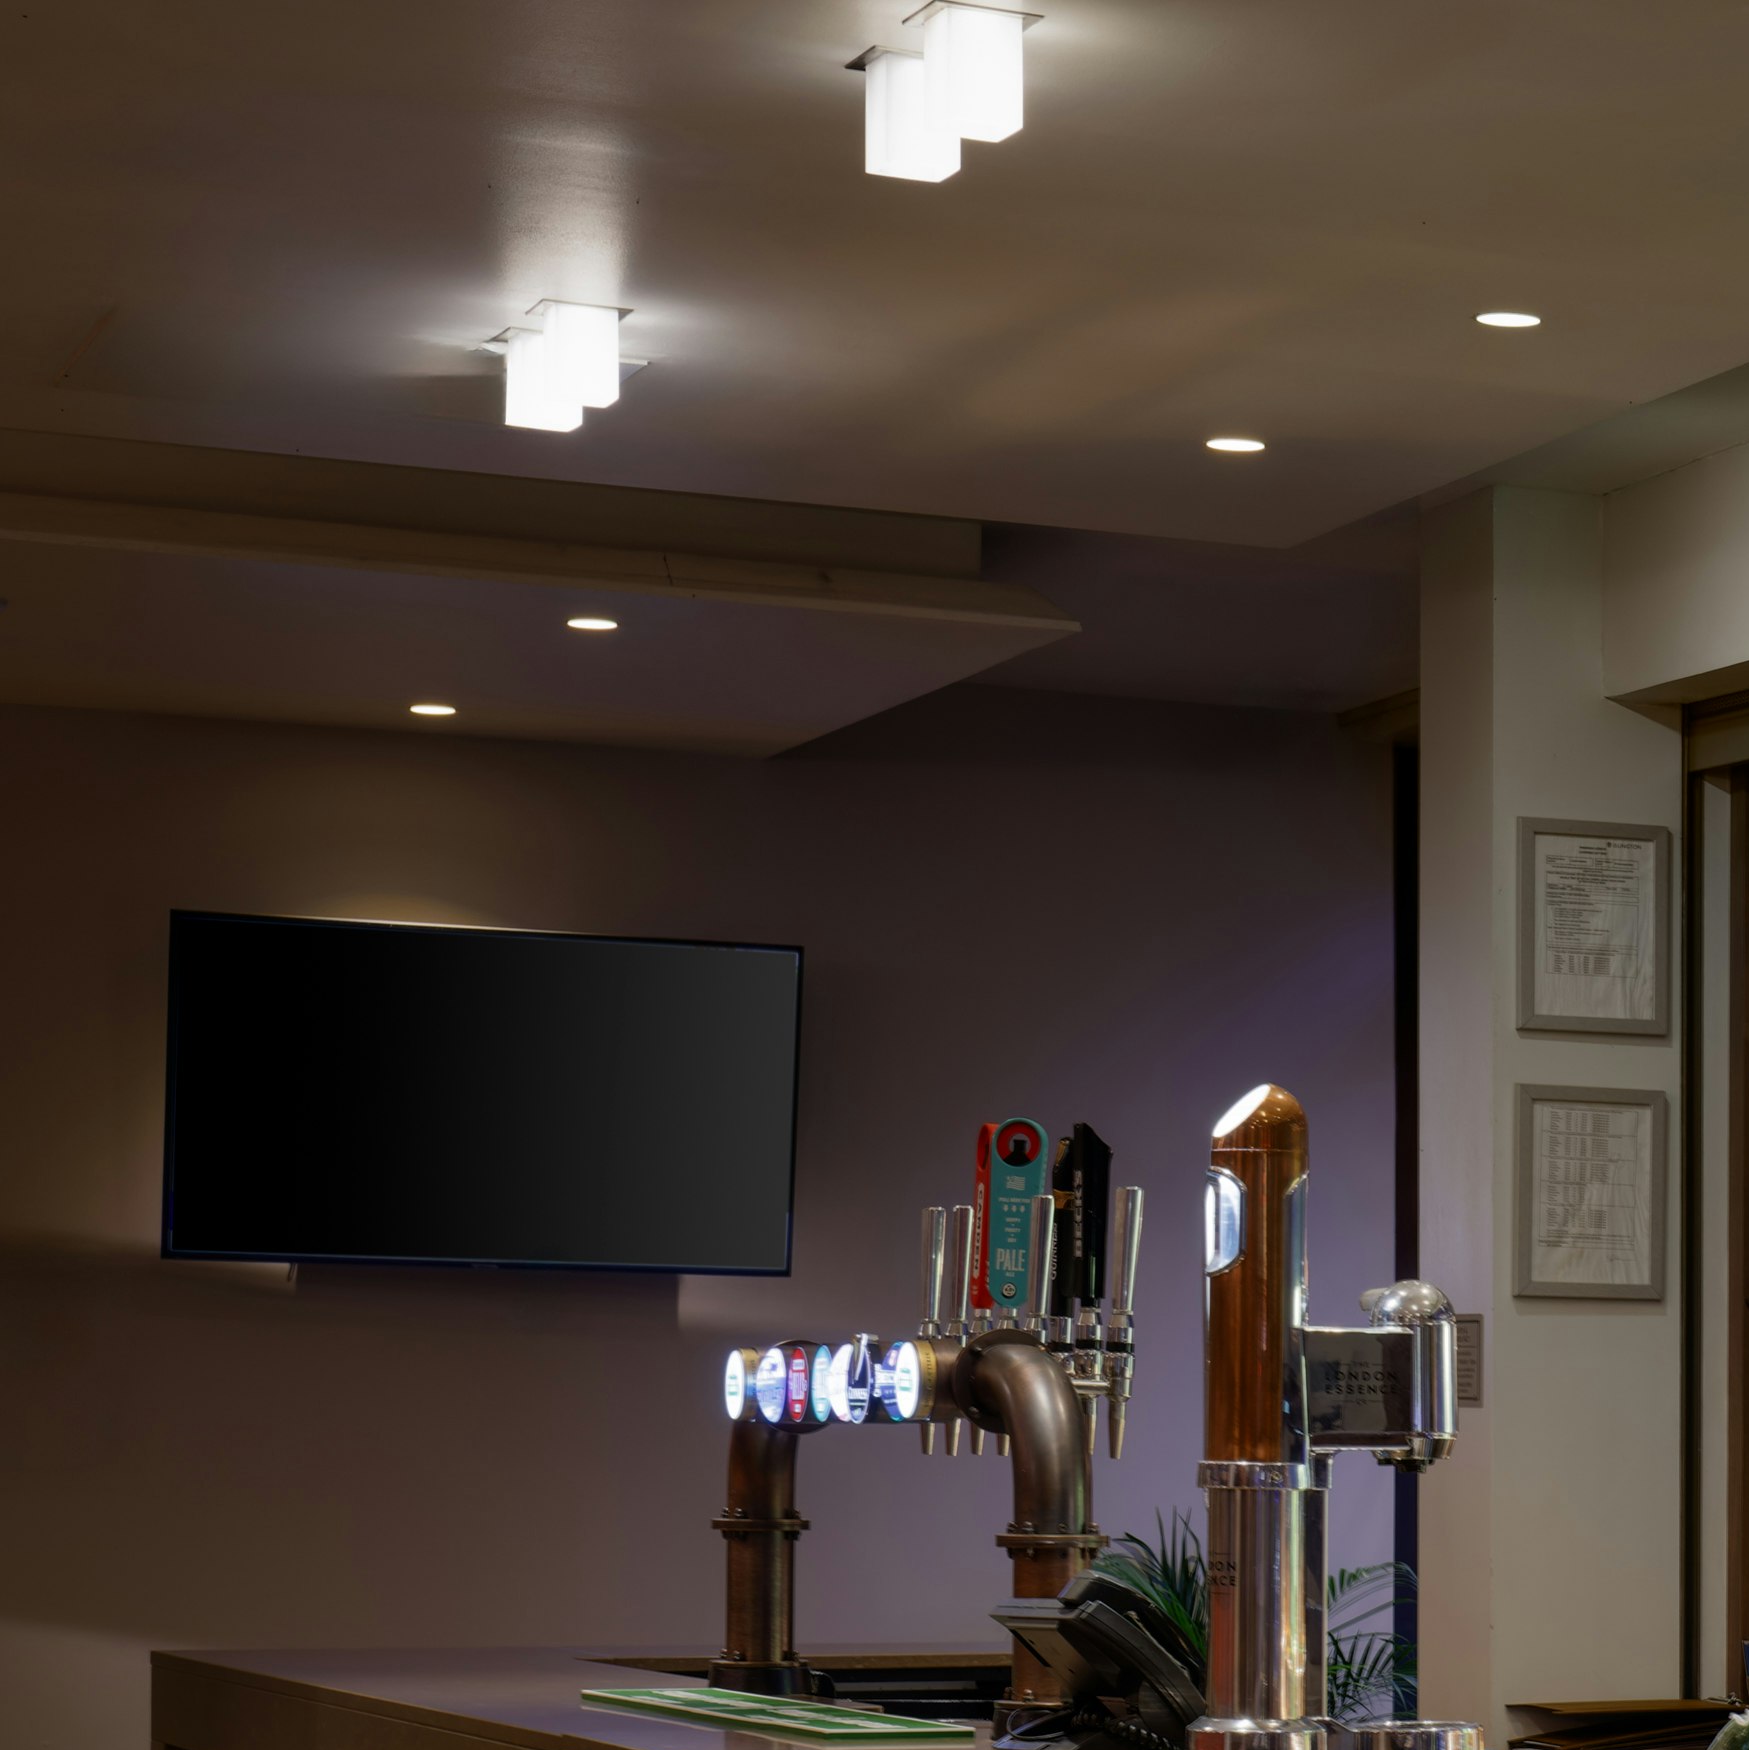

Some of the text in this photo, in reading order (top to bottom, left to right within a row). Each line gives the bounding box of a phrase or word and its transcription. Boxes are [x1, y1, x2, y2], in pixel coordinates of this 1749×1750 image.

[996, 1248, 1026, 1272] PALE
[1325, 1370, 1398, 1382] LONDON
[1325, 1384, 1399, 1395] ESSENCE
